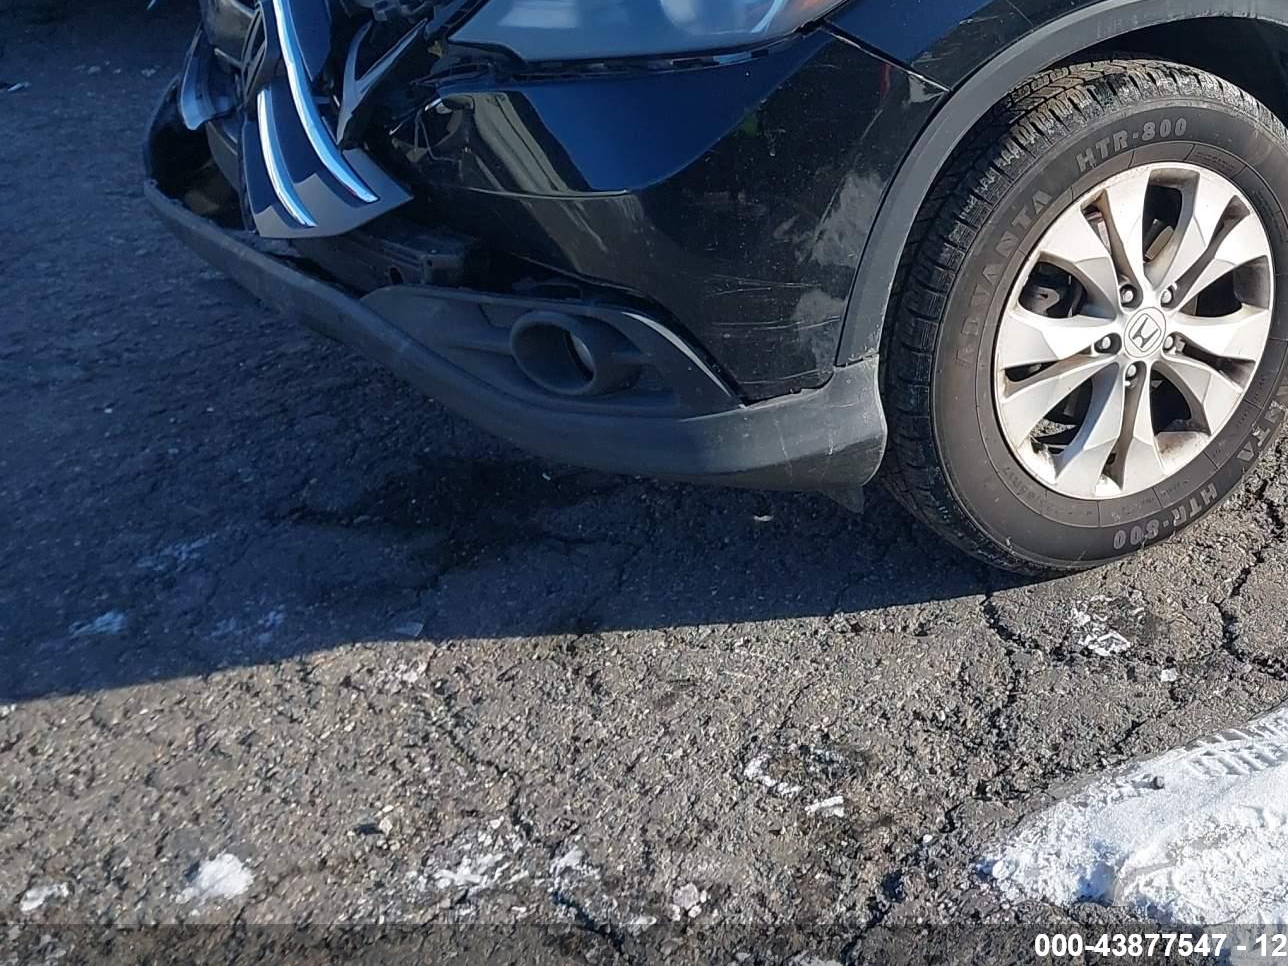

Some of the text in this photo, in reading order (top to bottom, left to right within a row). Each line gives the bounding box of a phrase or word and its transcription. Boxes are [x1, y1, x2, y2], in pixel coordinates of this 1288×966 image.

[956, 189, 1053, 365] ADVANTA
[1075, 118, 1188, 173] HTR-800
[1112, 484, 1219, 550] HTR-800
